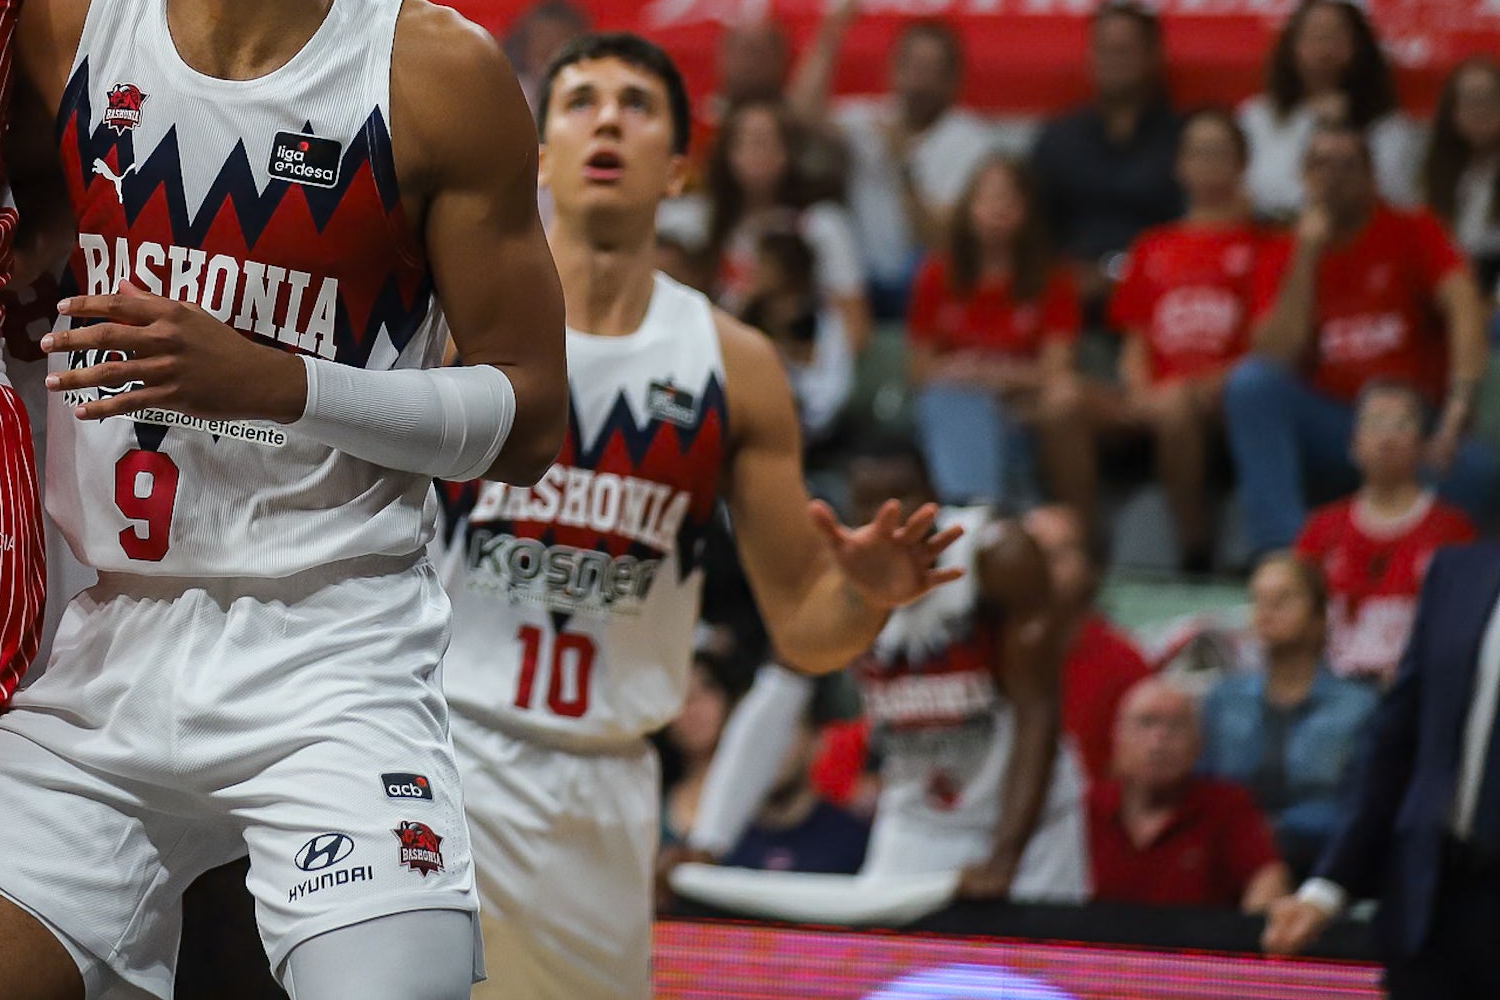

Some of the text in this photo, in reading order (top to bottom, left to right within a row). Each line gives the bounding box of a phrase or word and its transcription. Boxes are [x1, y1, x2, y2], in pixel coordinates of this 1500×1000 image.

[273, 160, 334, 181] endesa
[277, 145, 305, 162] liga
[79, 233, 340, 361] BASKONIA
[208, 417, 285, 445] eficiente
[114, 449, 180, 562] 9
[468, 462, 693, 547] BASKONIA
[513, 623, 598, 718] 10
[388, 782, 423, 798] acb
[288, 865, 374, 903] HYUNDAI
